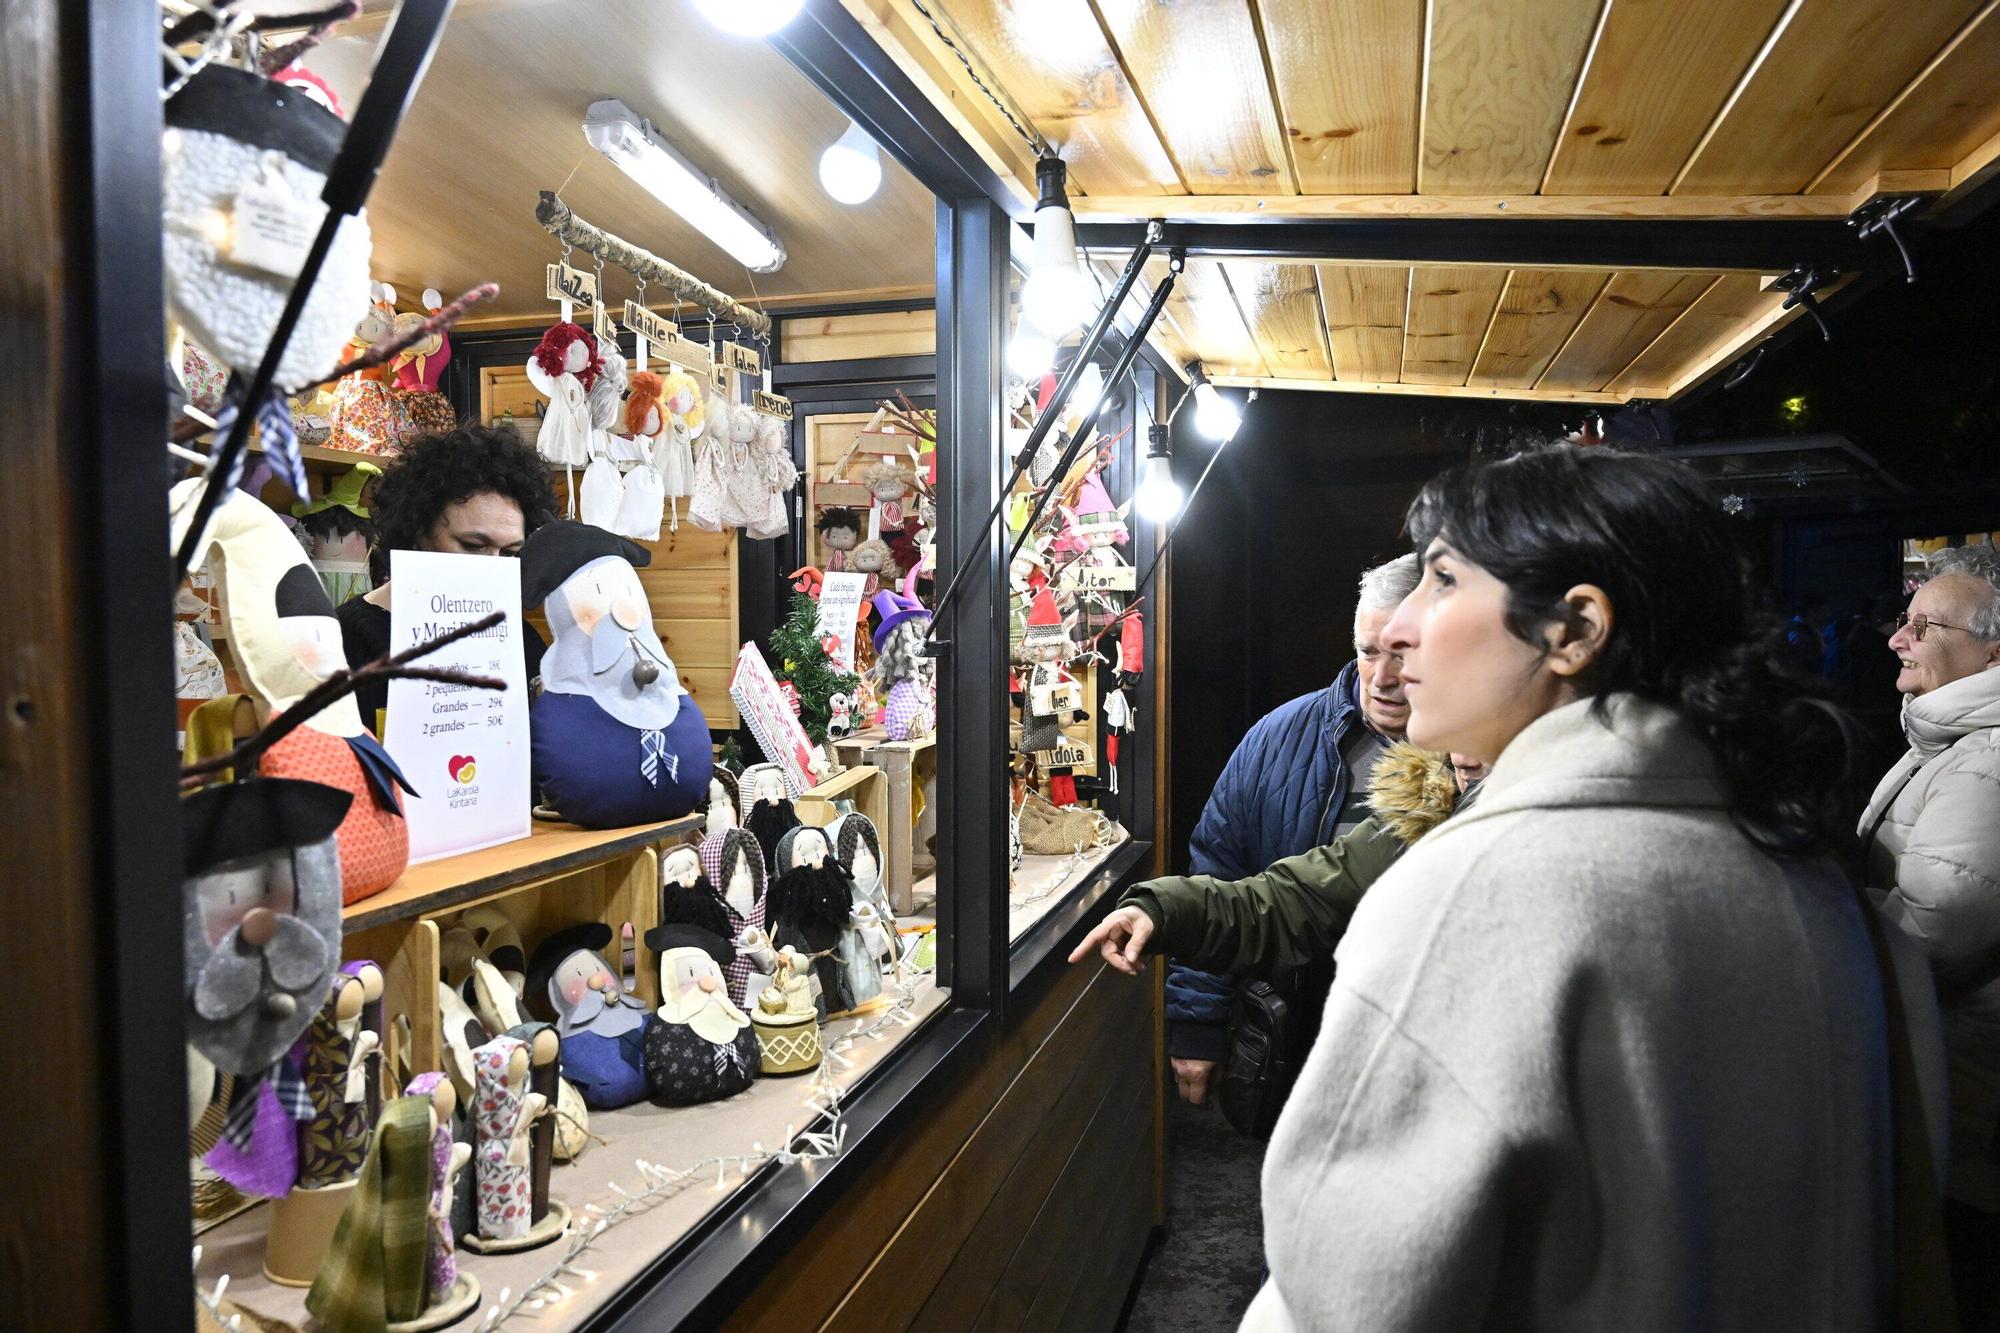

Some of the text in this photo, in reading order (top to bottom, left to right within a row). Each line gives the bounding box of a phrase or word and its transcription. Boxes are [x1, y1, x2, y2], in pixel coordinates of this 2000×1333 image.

[430, 593, 493, 614] Olentzero
[412, 627, 421, 646] y
[424, 621, 456, 641] Mari
[425, 684, 431, 695] 2
[432, 696, 503, 714] Grandes 29€
[422, 714, 504, 737] 2 grandes 50€
